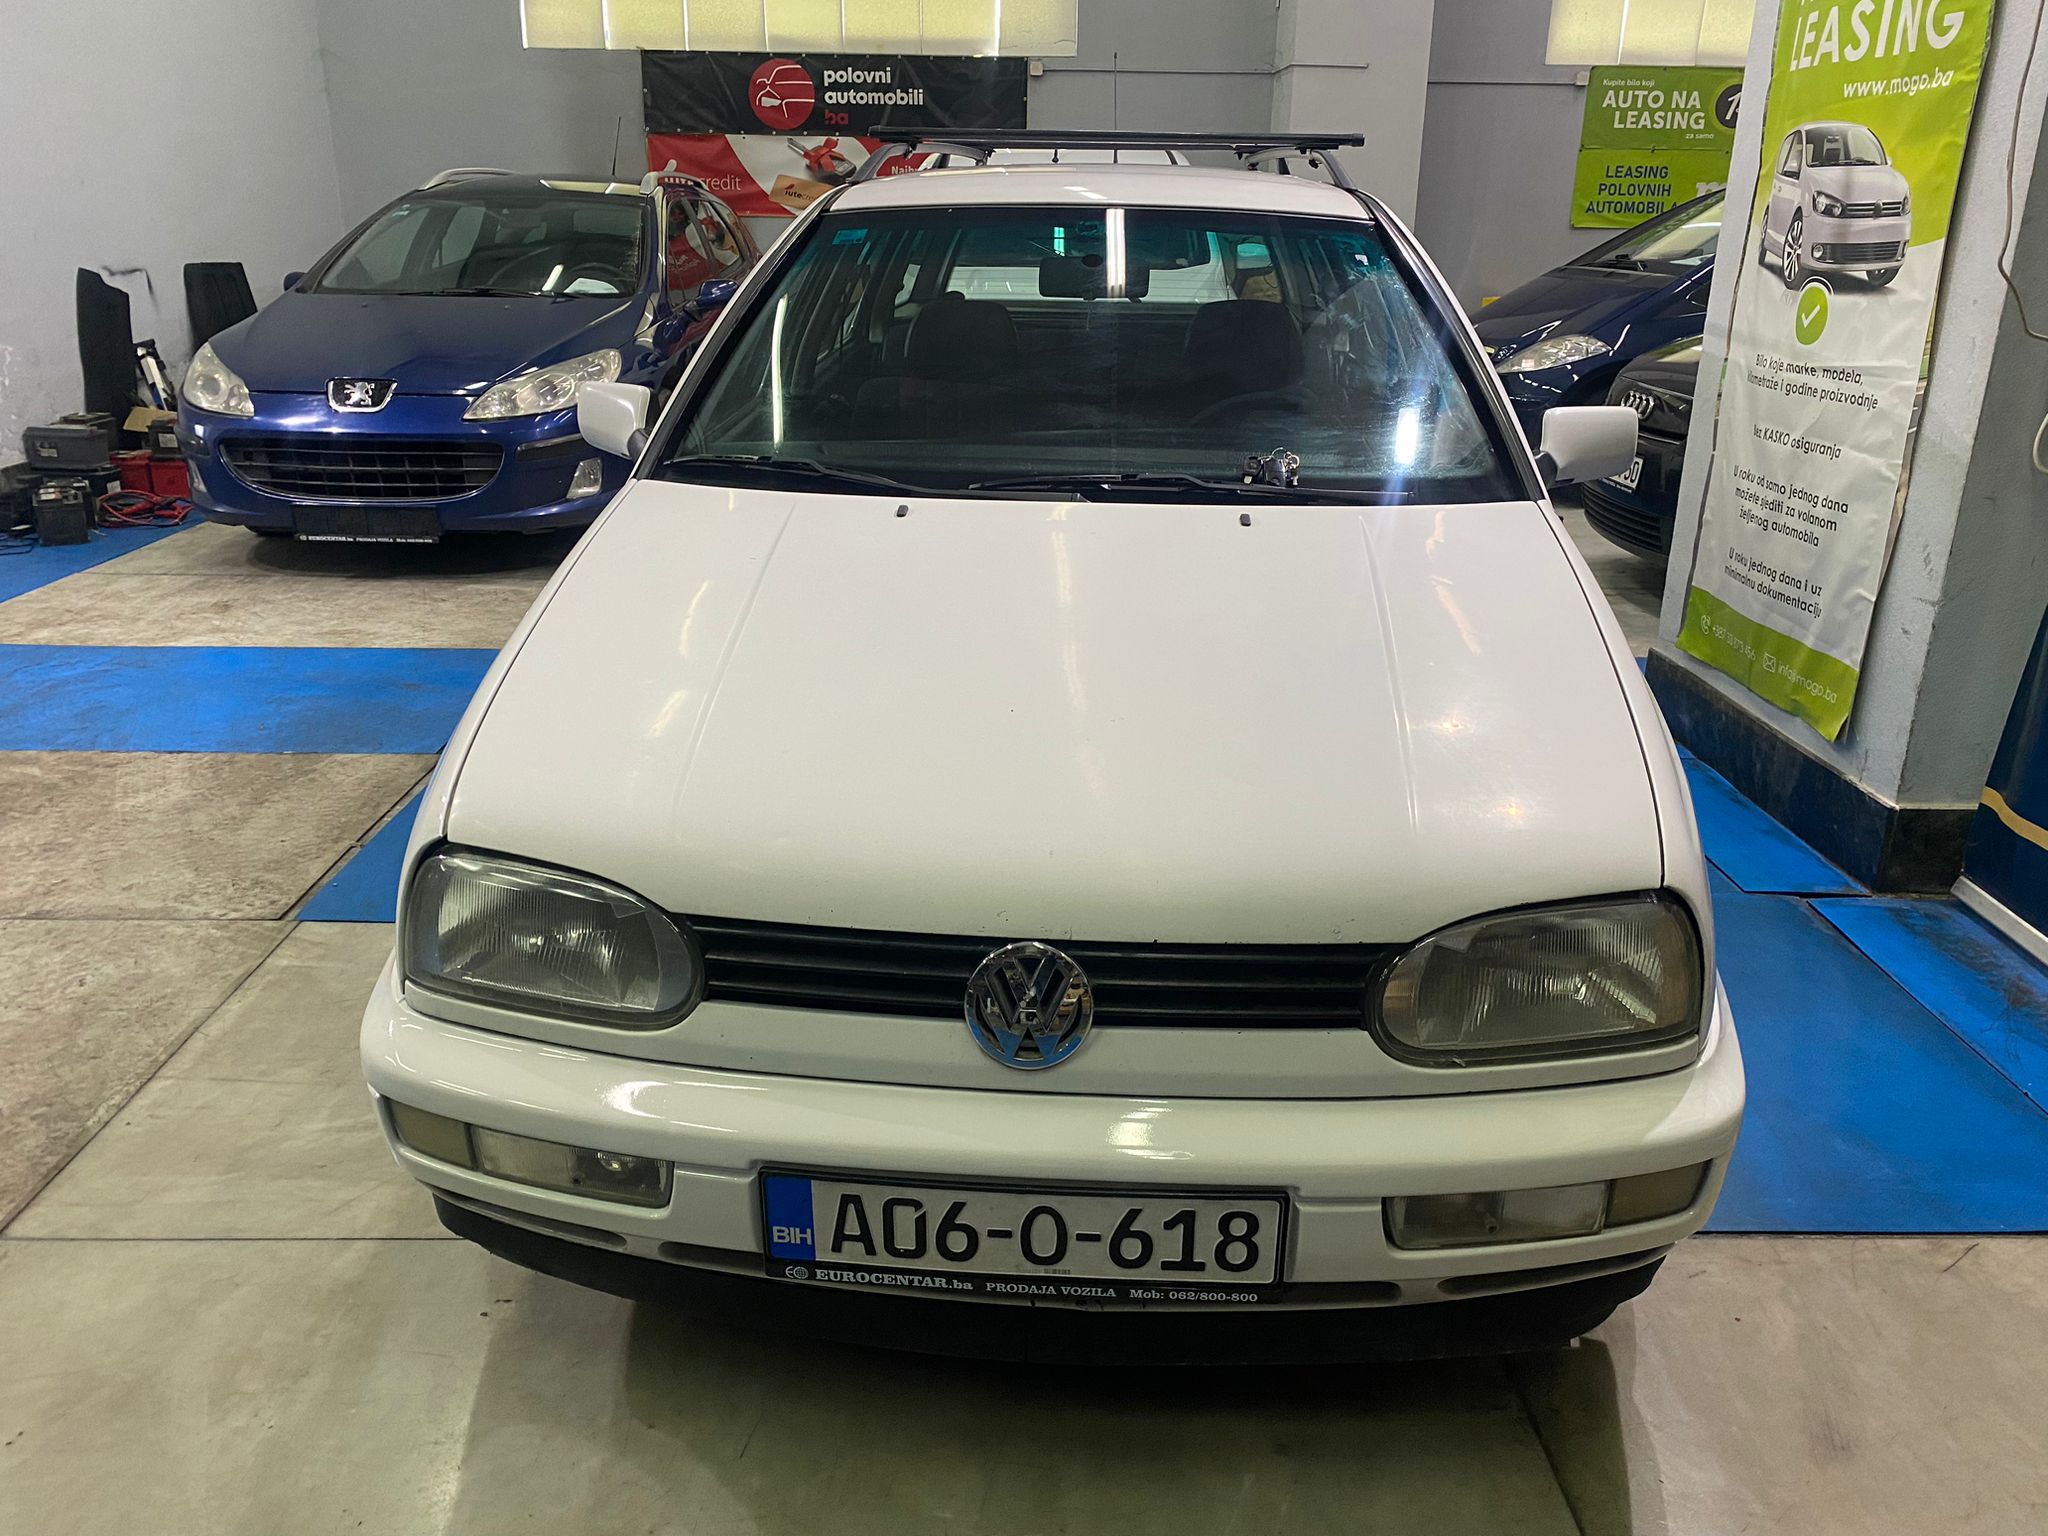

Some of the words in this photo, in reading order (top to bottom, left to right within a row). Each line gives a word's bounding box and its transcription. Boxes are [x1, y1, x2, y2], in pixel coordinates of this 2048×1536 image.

[1789, 0, 1965, 72] LEASING
[823, 66, 891, 87] polovni
[1602, 78, 1625, 87] Kupite
[1642, 79, 1655, 88] koji
[1843, 67, 1954, 97] www.mogo.ba
[824, 88, 924, 106] automobili
[1602, 89, 1665, 109] AUTO
[1671, 90, 1701, 109] NA
[1613, 111, 1705, 130] LEASING
[1605, 165, 1669, 180] LEASING
[1598, 183, 1672, 198] POLOVNIH
[1586, 201, 1678, 215] AUTOMOBIL
[1769, 356, 1784, 374] koje
[1786, 362, 1820, 379] marke,
[1822, 368, 1863, 387] modela,
[1785, 382, 1818, 398] godine
[1820, 388, 1878, 412] proizvodnje
[1763, 427, 1790, 446] KASKO
[1791, 437, 1841, 461] osiguranja
[1739, 468, 1756, 484] roku
[1757, 474, 1765, 488] od
[1766, 480, 1786, 495] samo
[1788, 484, 1819, 509] jednog
[1821, 495, 1849, 514] dana
[1785, 505, 1796, 518] za
[1798, 509, 1837, 532] volanom
[1771, 521, 1820, 547] automobila
[1748, 557, 1777, 583] jednog
[1779, 571, 1802, 590] dana
[1811, 584, 1822, 597] uz
[1757, 581, 1822, 619] dokumentaciju
[771, 1225, 813, 1246] BIH
[815, 1268, 974, 1291] EUROCENTAR.ba
[985, 1281, 1056, 1296] PRODAJA
[1060, 1286, 1116, 1298] VOZILA
[1130, 1288, 1164, 1300] Mob:
[1169, 1290, 1258, 1302] 062/800-800
